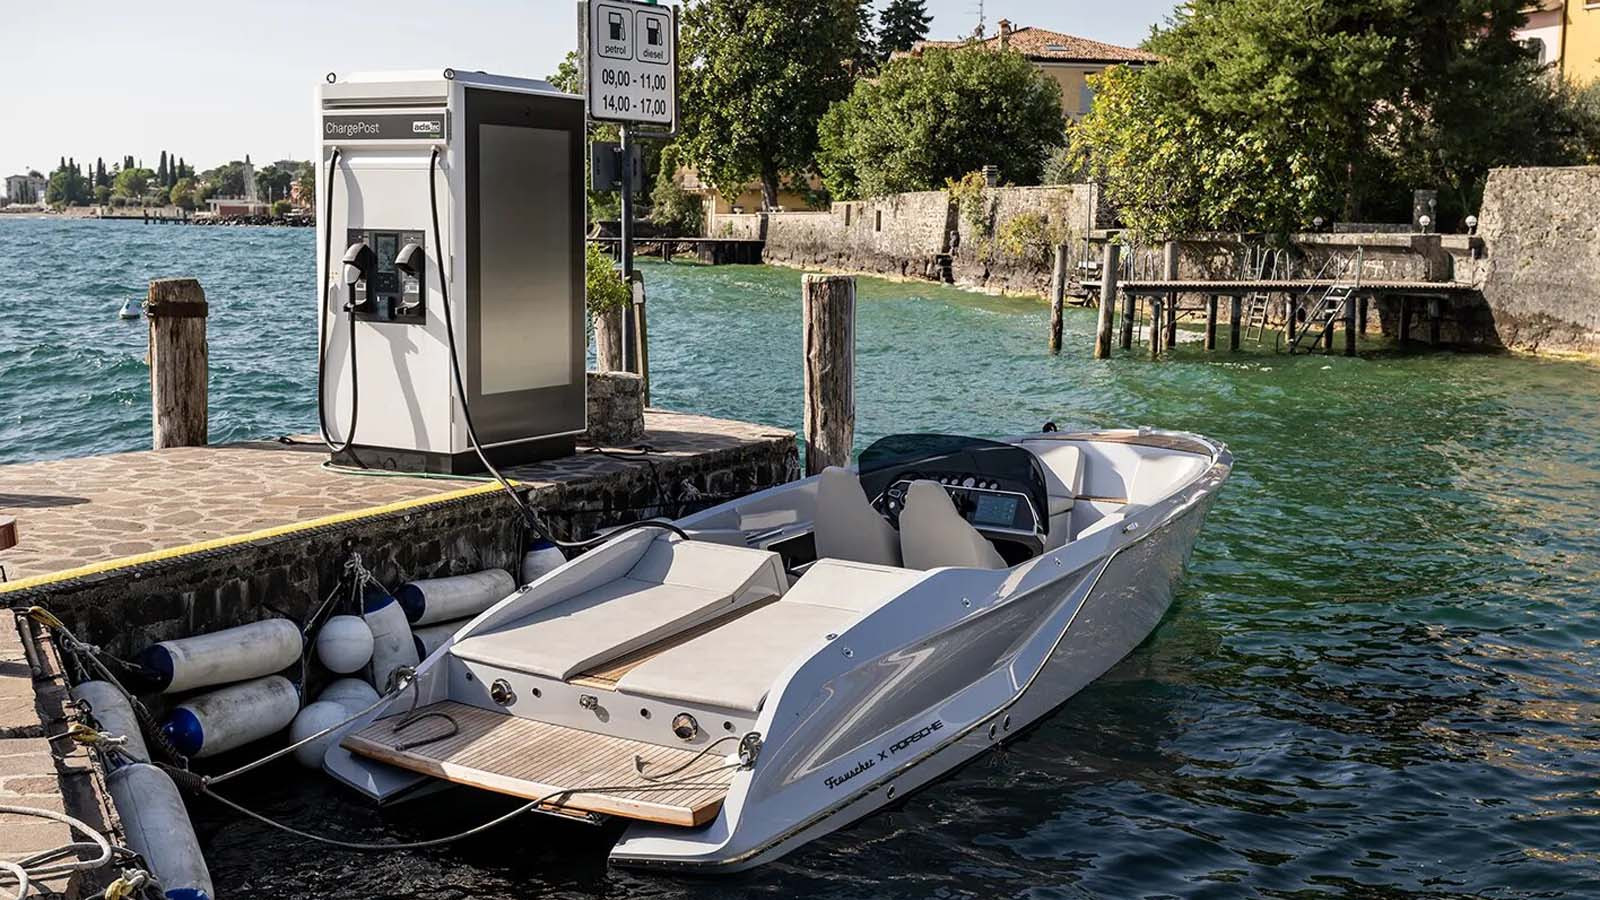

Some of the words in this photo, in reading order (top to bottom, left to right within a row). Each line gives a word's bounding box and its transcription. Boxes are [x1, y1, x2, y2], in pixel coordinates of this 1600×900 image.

[605, 45, 627, 55] petrol
[643, 49, 664, 59] diesel
[602, 68, 631, 88] 09,00
[640, 73, 666, 92] 11,00
[602, 94, 631, 114] 14,00
[640, 98, 666, 117] 17,00
[325, 121, 380, 136] ChargePost
[824, 759, 875, 789] Frauscher
[889, 719, 944, 754] PORSCHE
